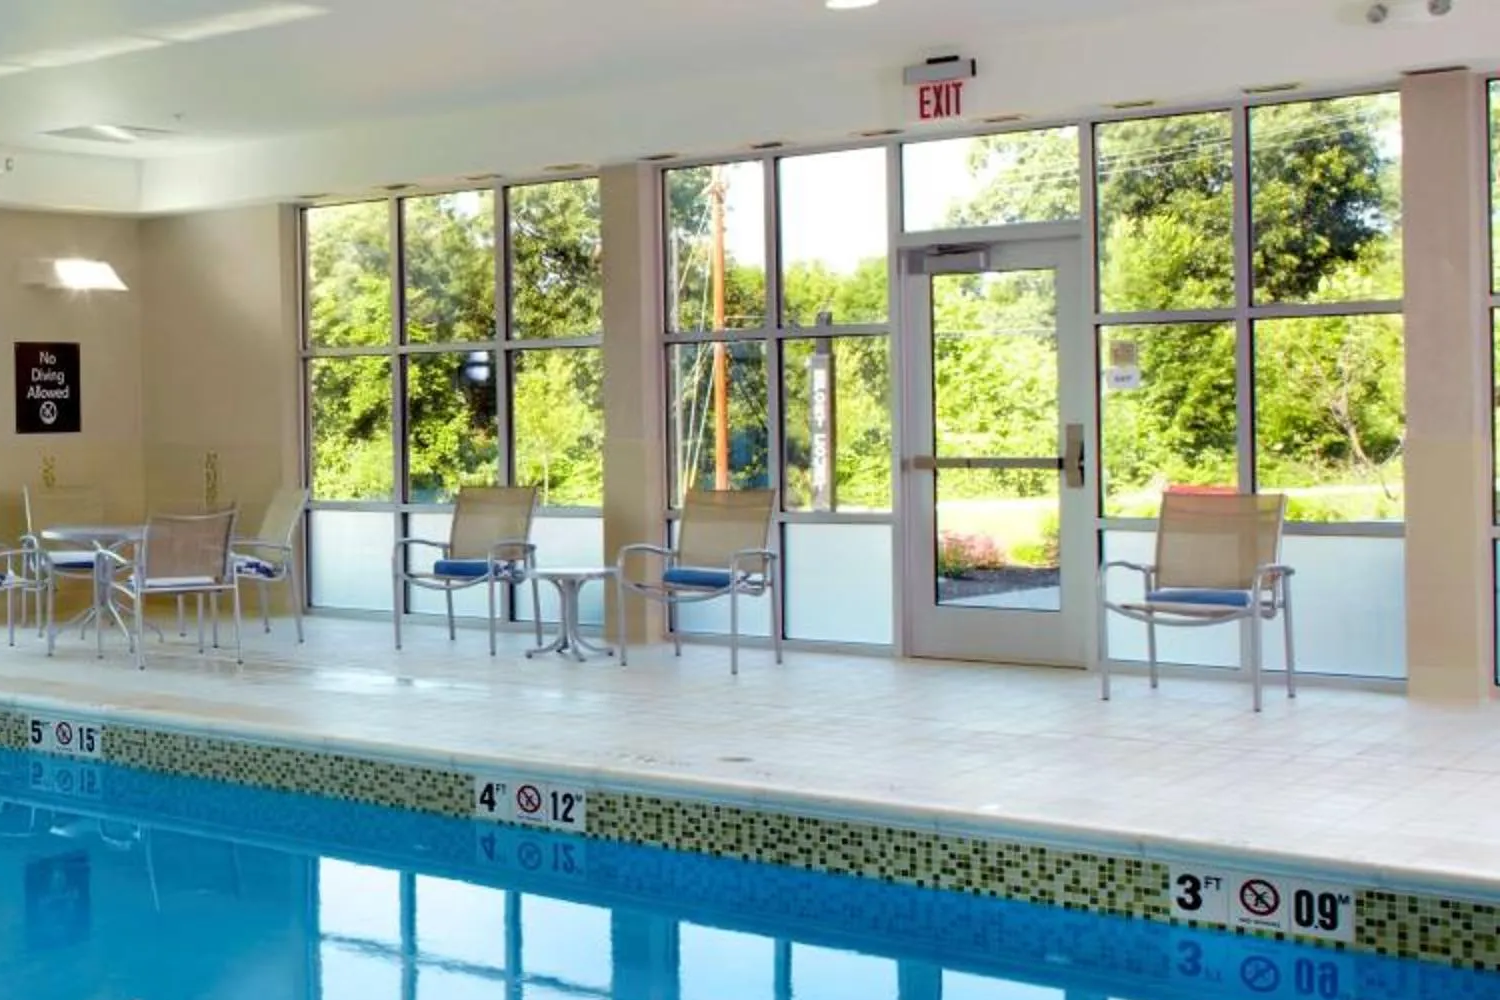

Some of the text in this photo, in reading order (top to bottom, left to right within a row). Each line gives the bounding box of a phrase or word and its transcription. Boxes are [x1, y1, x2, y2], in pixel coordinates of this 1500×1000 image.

[919, 82, 963, 119] EXIT
[39, 351, 56, 365] No
[31, 367, 65, 385] Diving
[26, 385, 70, 399] Allowed
[31, 719, 43, 744] 5
[480, 783, 496, 812] 4
[1176, 874, 1202, 911] 3
[1204, 876, 1223, 891] FT
